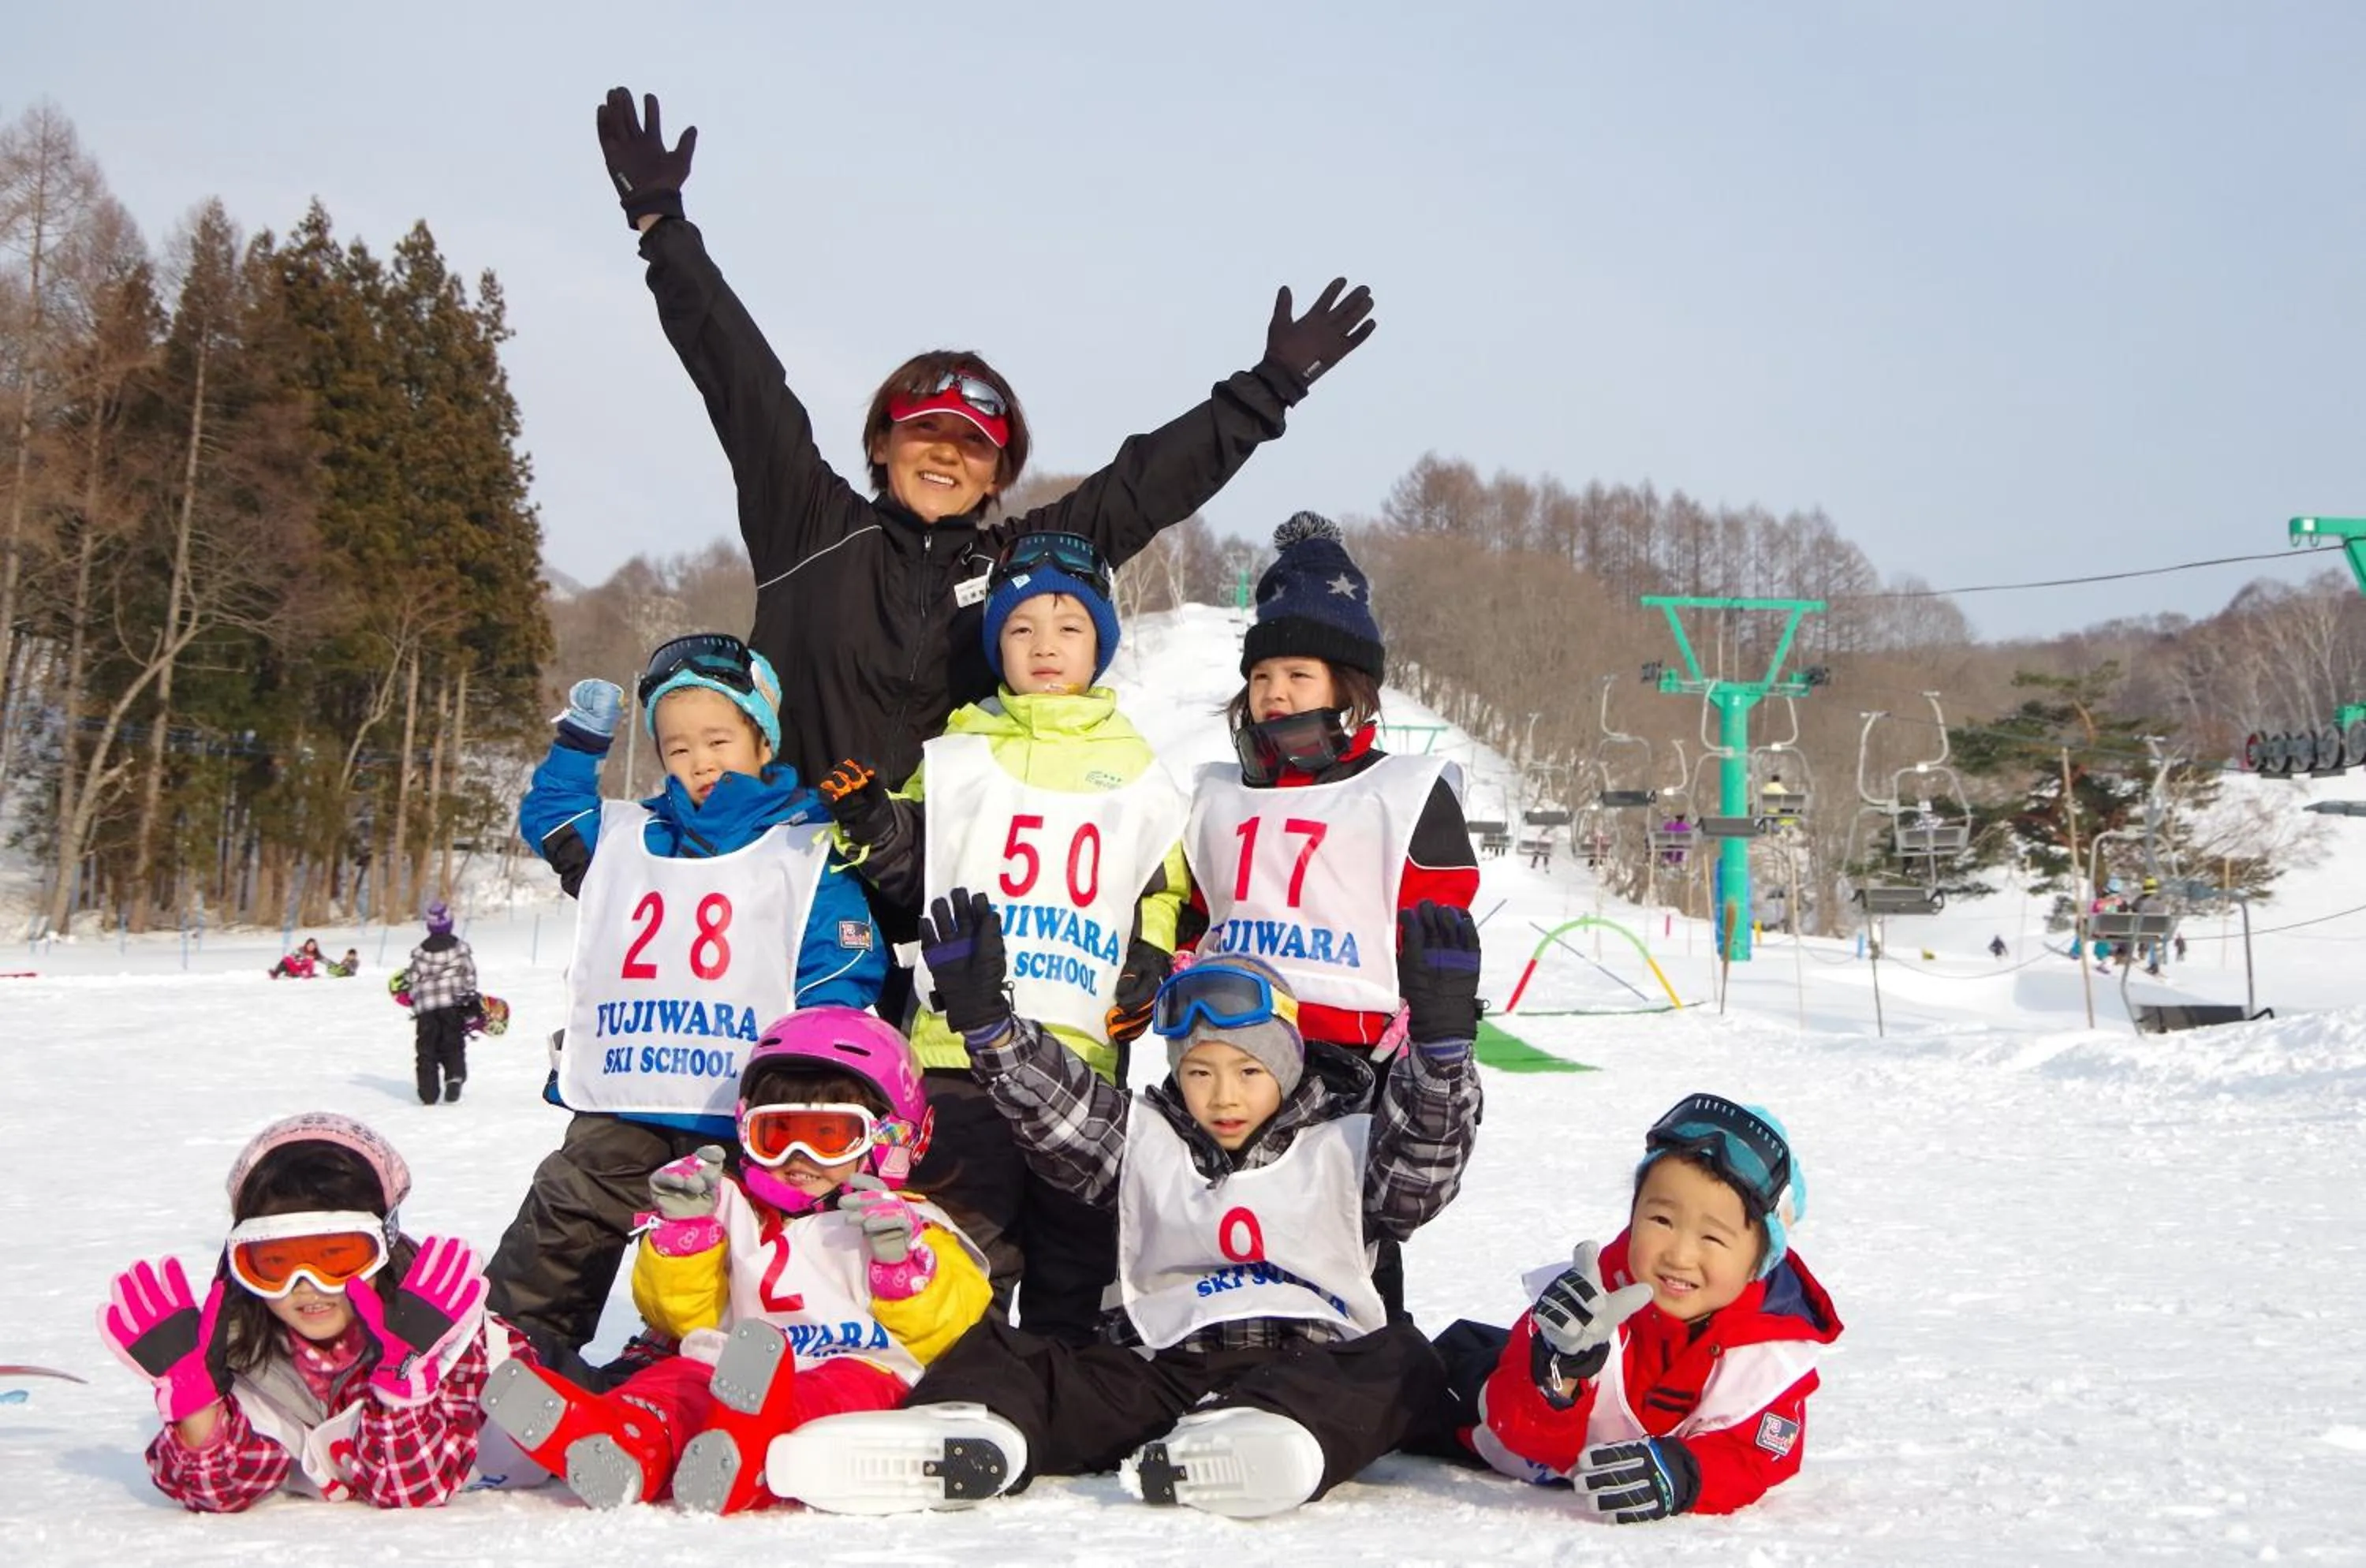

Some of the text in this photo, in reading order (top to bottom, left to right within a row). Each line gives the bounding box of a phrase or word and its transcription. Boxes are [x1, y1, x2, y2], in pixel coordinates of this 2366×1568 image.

[999, 814, 1101, 908] 50
[1234, 816, 1328, 908] 17
[621, 890, 733, 980] 28
[988, 904, 1120, 966] JIWARA
[1013, 950, 1098, 996] SCHOOL
[596, 999, 759, 1042] FUJIWARA
[603, 1046, 737, 1079] SKI SCHOOL
